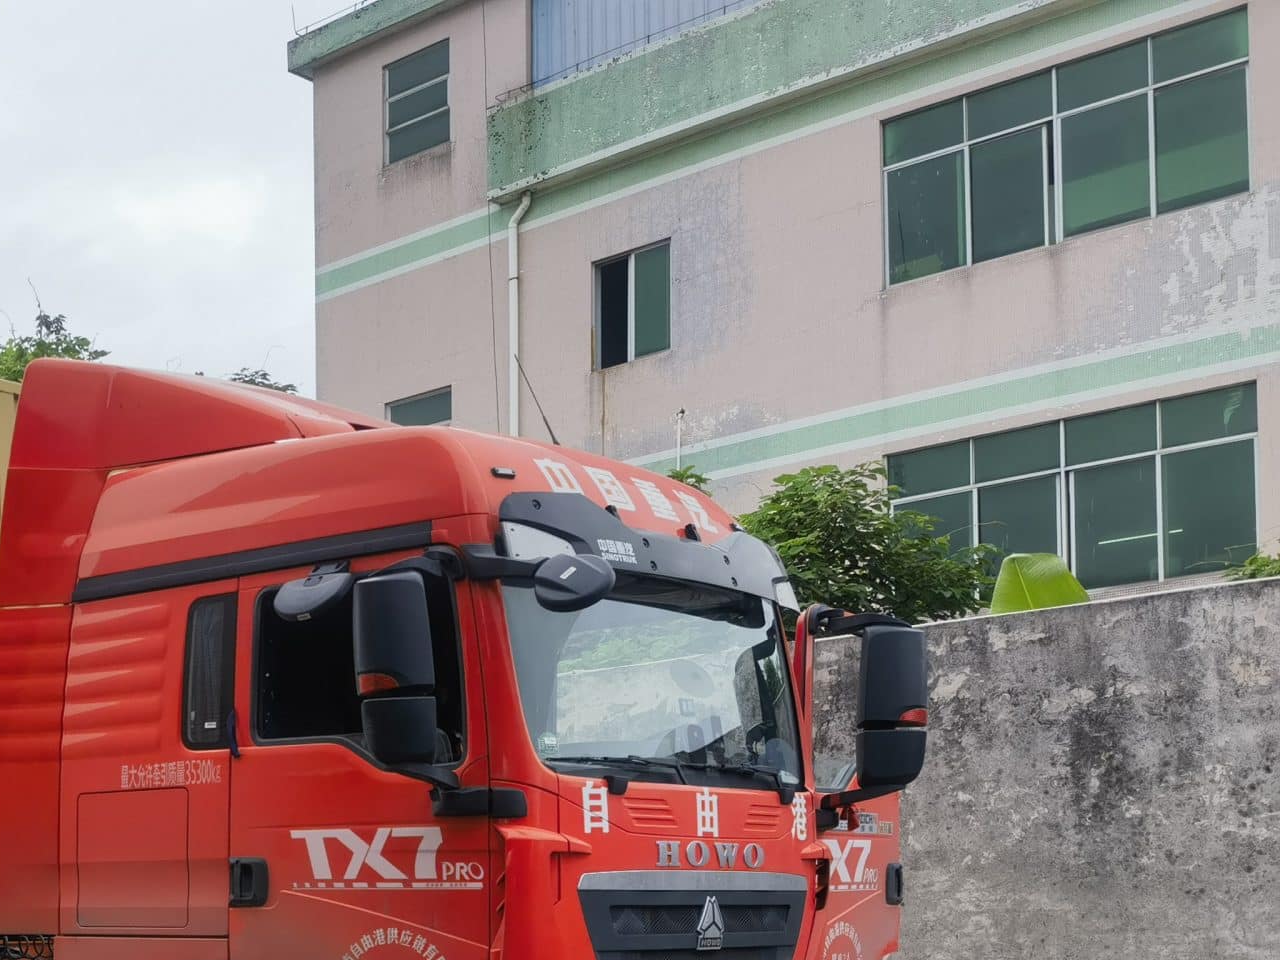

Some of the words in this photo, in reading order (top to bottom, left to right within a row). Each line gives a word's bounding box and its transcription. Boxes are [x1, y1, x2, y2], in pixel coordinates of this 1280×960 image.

[533, 458, 719, 534] 中国重汽
[289, 826, 443, 880] TX7
[441, 861, 484, 881] PRO
[656, 840, 765, 869] HOWO
[821, 839, 872, 882] X7
